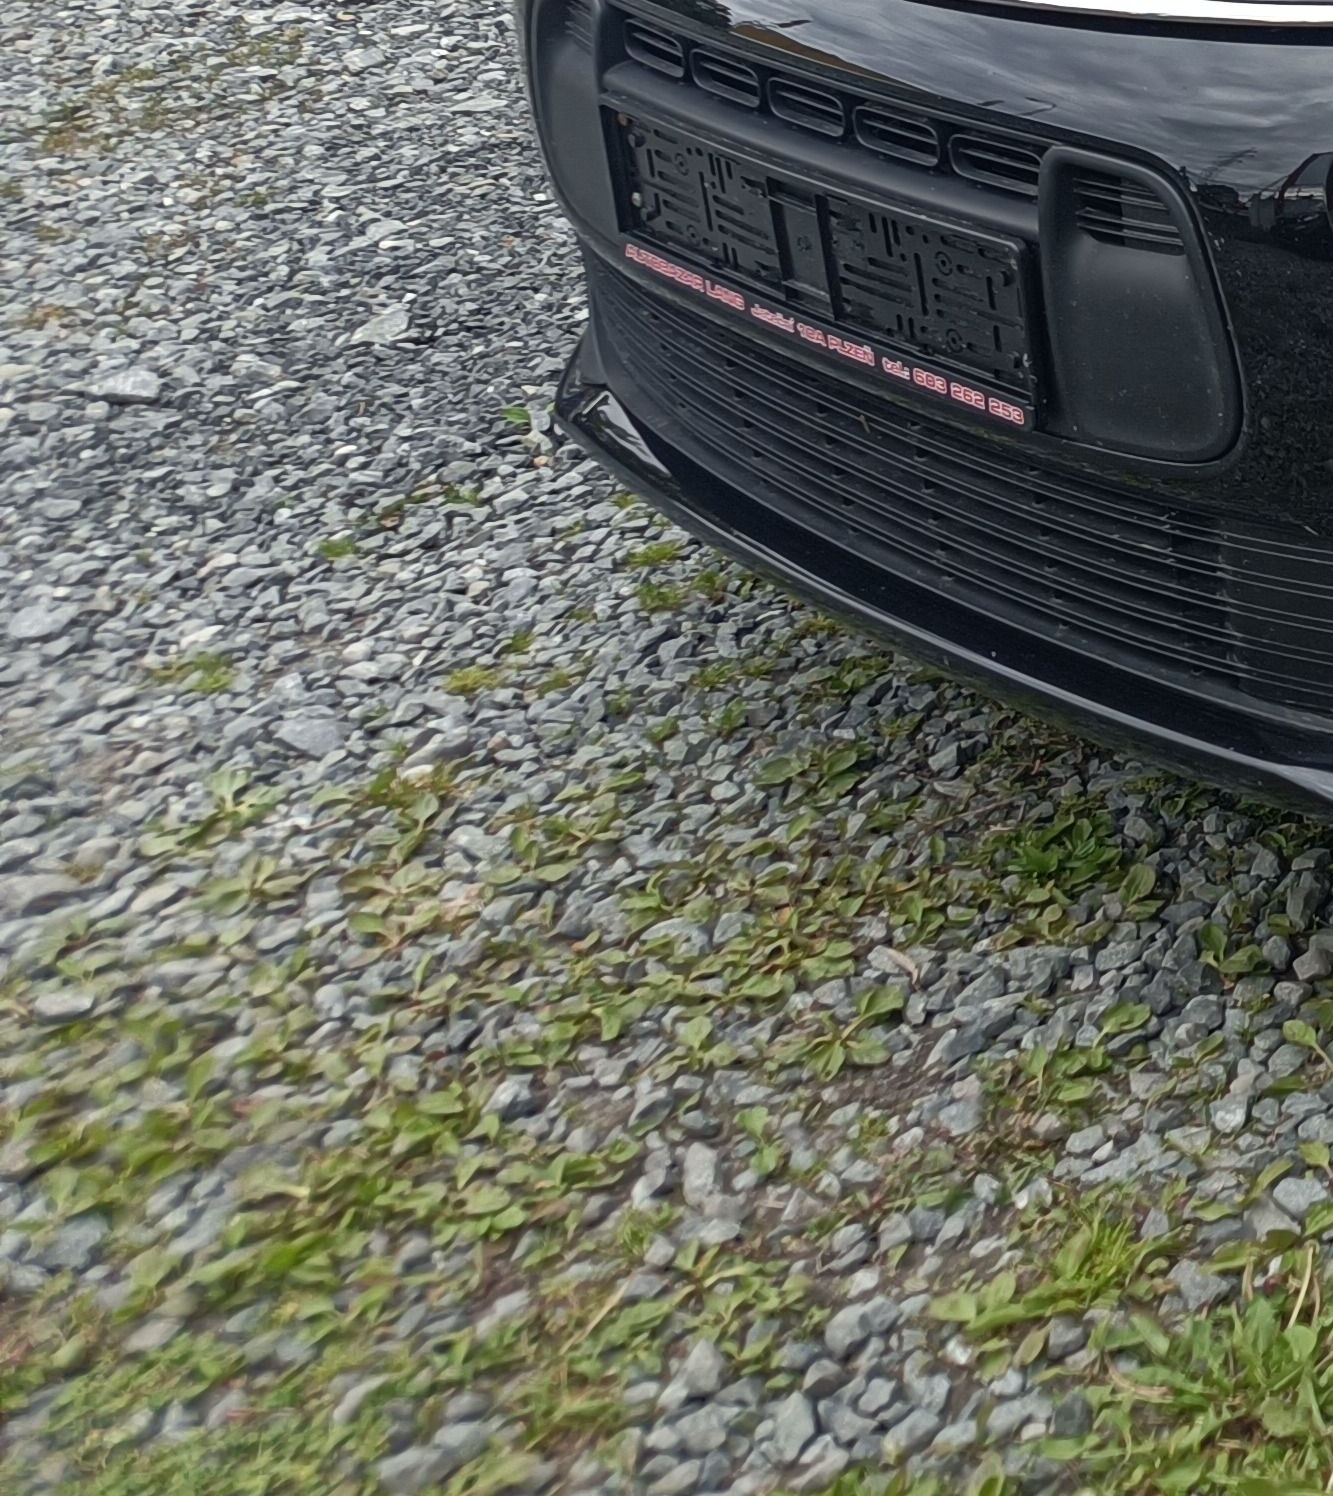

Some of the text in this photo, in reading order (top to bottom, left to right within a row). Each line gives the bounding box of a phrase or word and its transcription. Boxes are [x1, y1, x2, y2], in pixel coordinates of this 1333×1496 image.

[913, 367, 947, 394] 603
[950, 382, 985, 410] 262
[988, 397, 1024, 425] 253
